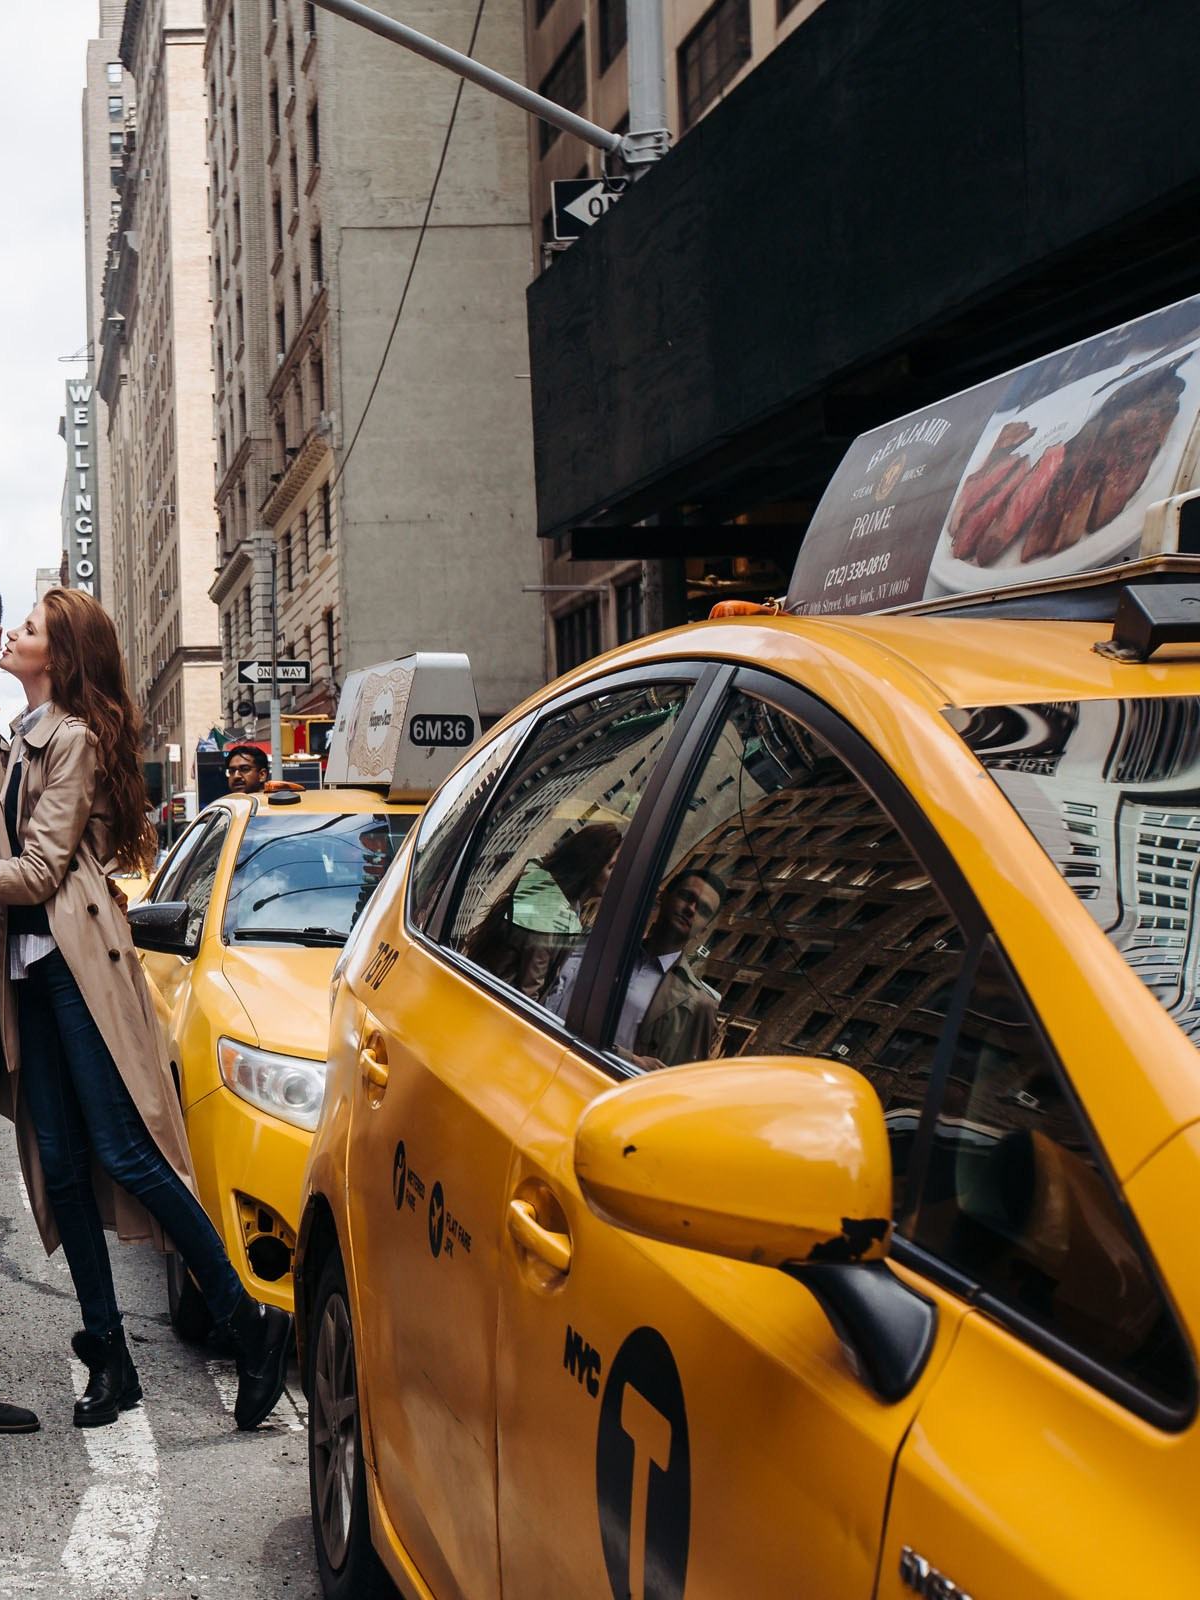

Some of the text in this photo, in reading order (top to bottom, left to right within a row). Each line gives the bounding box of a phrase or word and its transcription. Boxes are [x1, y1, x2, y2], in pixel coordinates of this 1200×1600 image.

[865, 418, 951, 474] BENJAMIN
[69, 386, 94, 597] WELLINGTON
[851, 484, 875, 501] STEAK
[850, 505, 895, 540] PRIME
[824, 552, 891, 591] (212) 338-0818
[281, 667, 302, 676] WAY
[413, 720, 466, 741] 6M36
[564, 1324, 602, 1399] NYC
